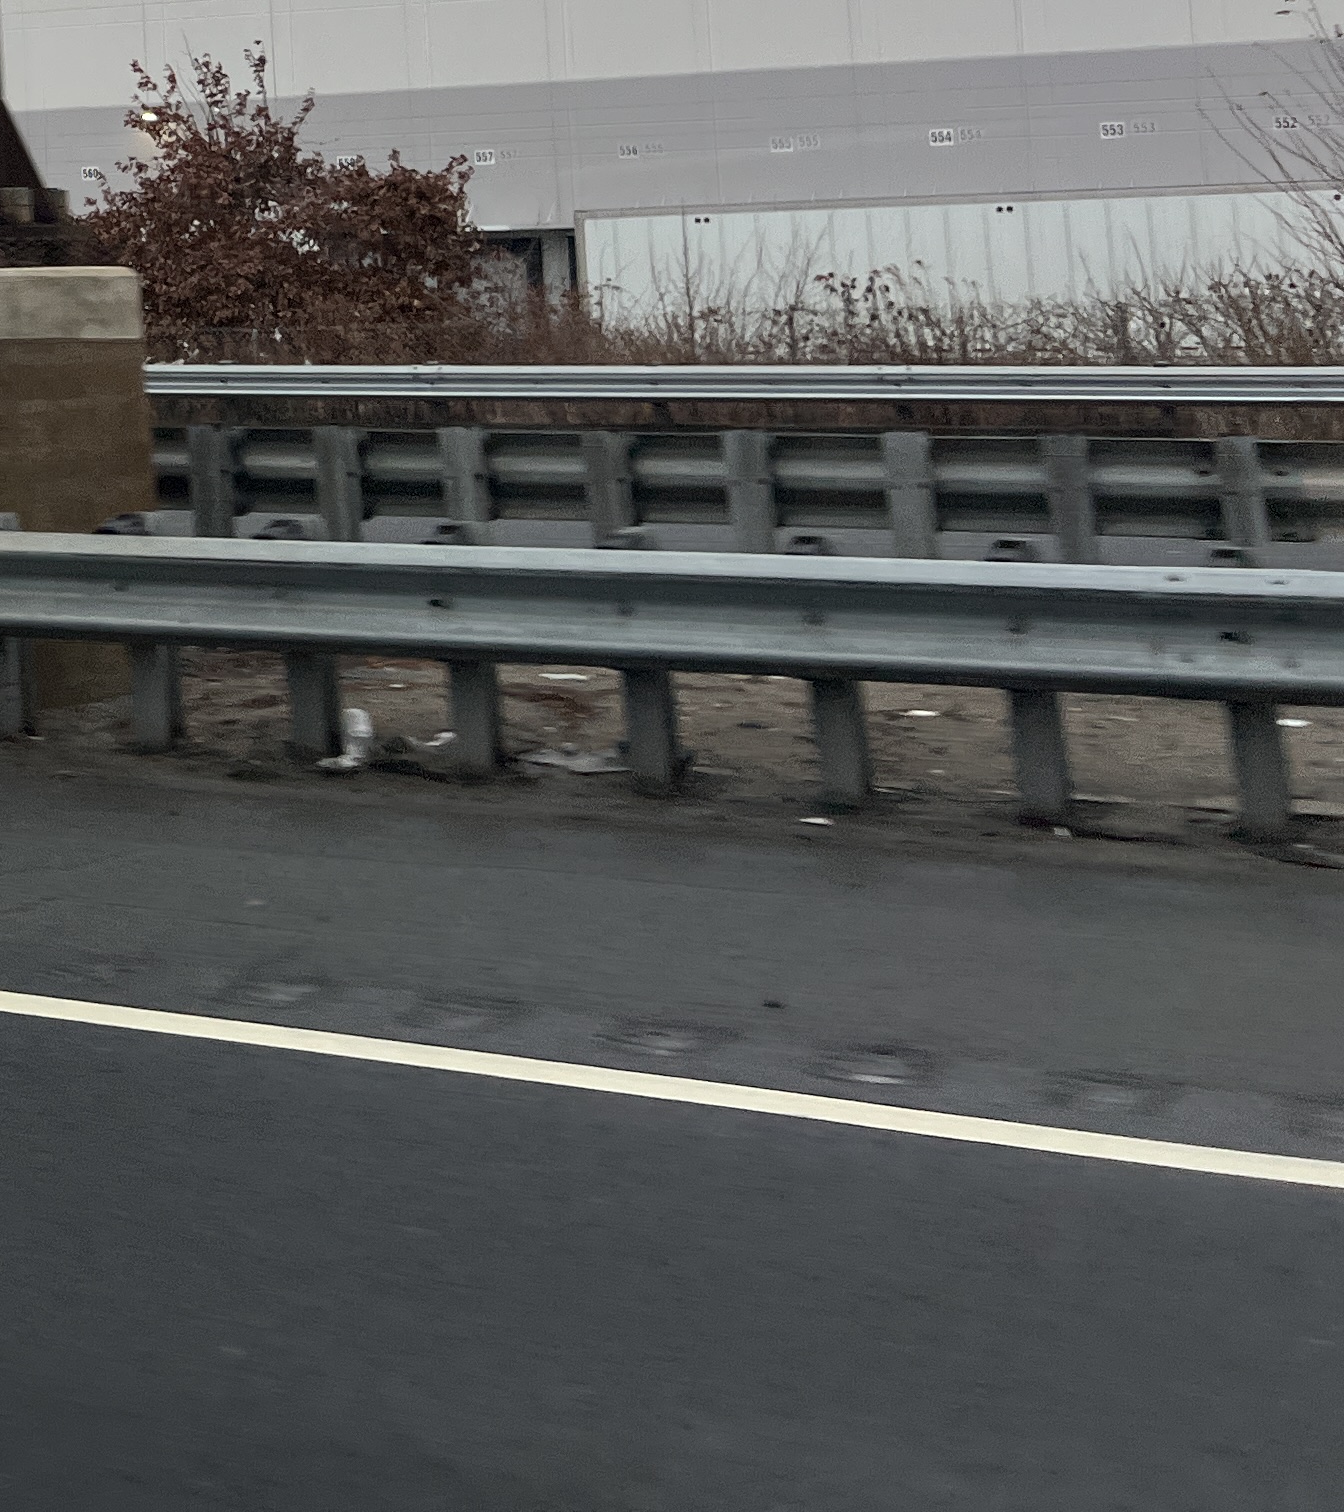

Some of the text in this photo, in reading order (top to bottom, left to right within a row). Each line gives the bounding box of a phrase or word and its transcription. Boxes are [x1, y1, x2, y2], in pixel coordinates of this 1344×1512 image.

[929, 130, 952, 144] 554
[1100, 123, 1124, 137] 553
[475, 151, 493, 163] 557
